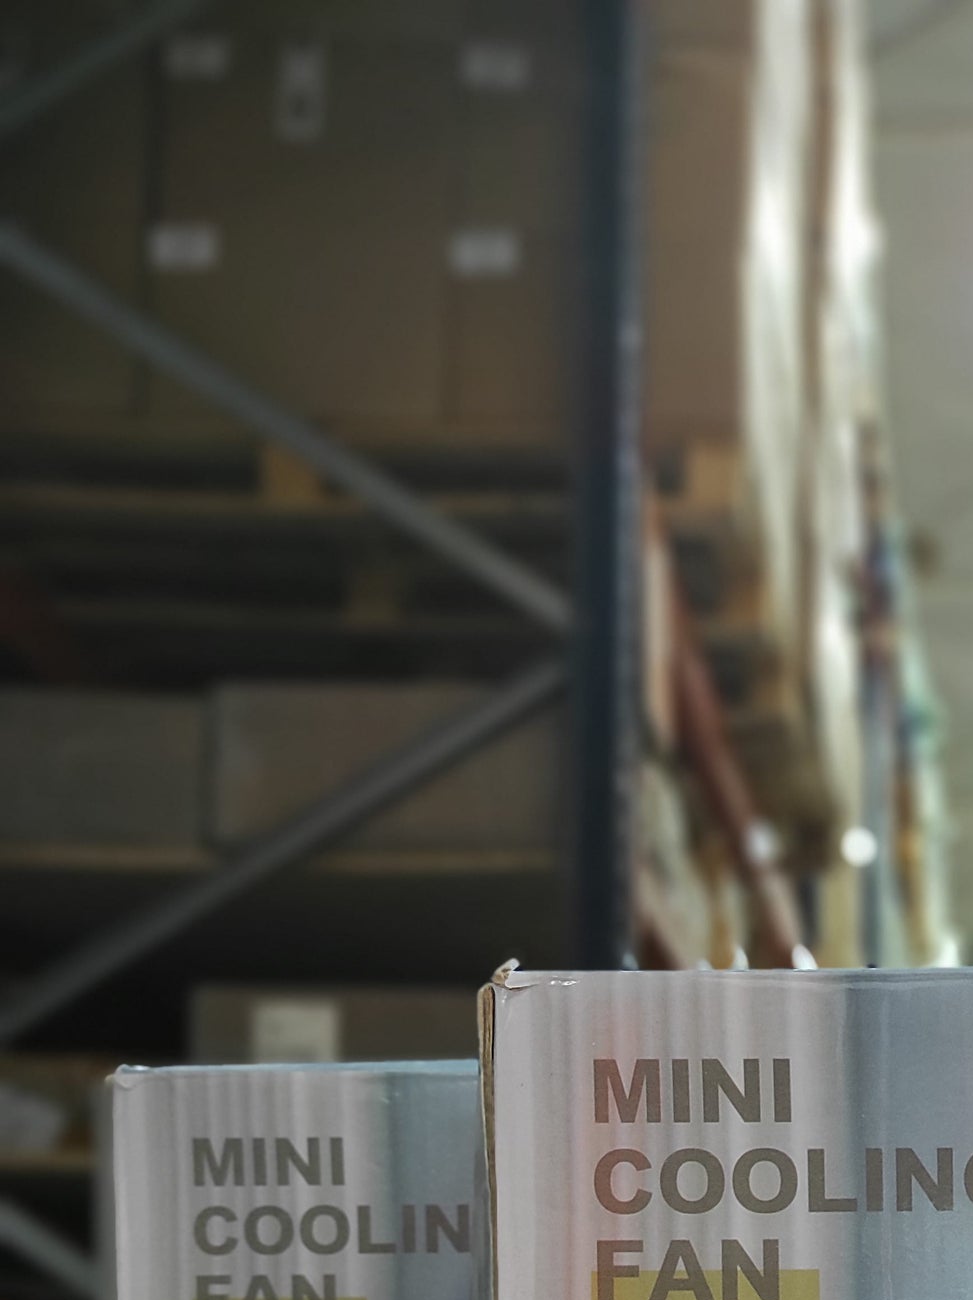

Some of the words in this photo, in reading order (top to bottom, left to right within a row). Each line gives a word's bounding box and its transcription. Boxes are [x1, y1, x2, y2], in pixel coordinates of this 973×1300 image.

[593, 1058, 792, 1124] MINI
[192, 1137, 345, 1187] MINI
[193, 1204, 472, 1255] COOLIN
